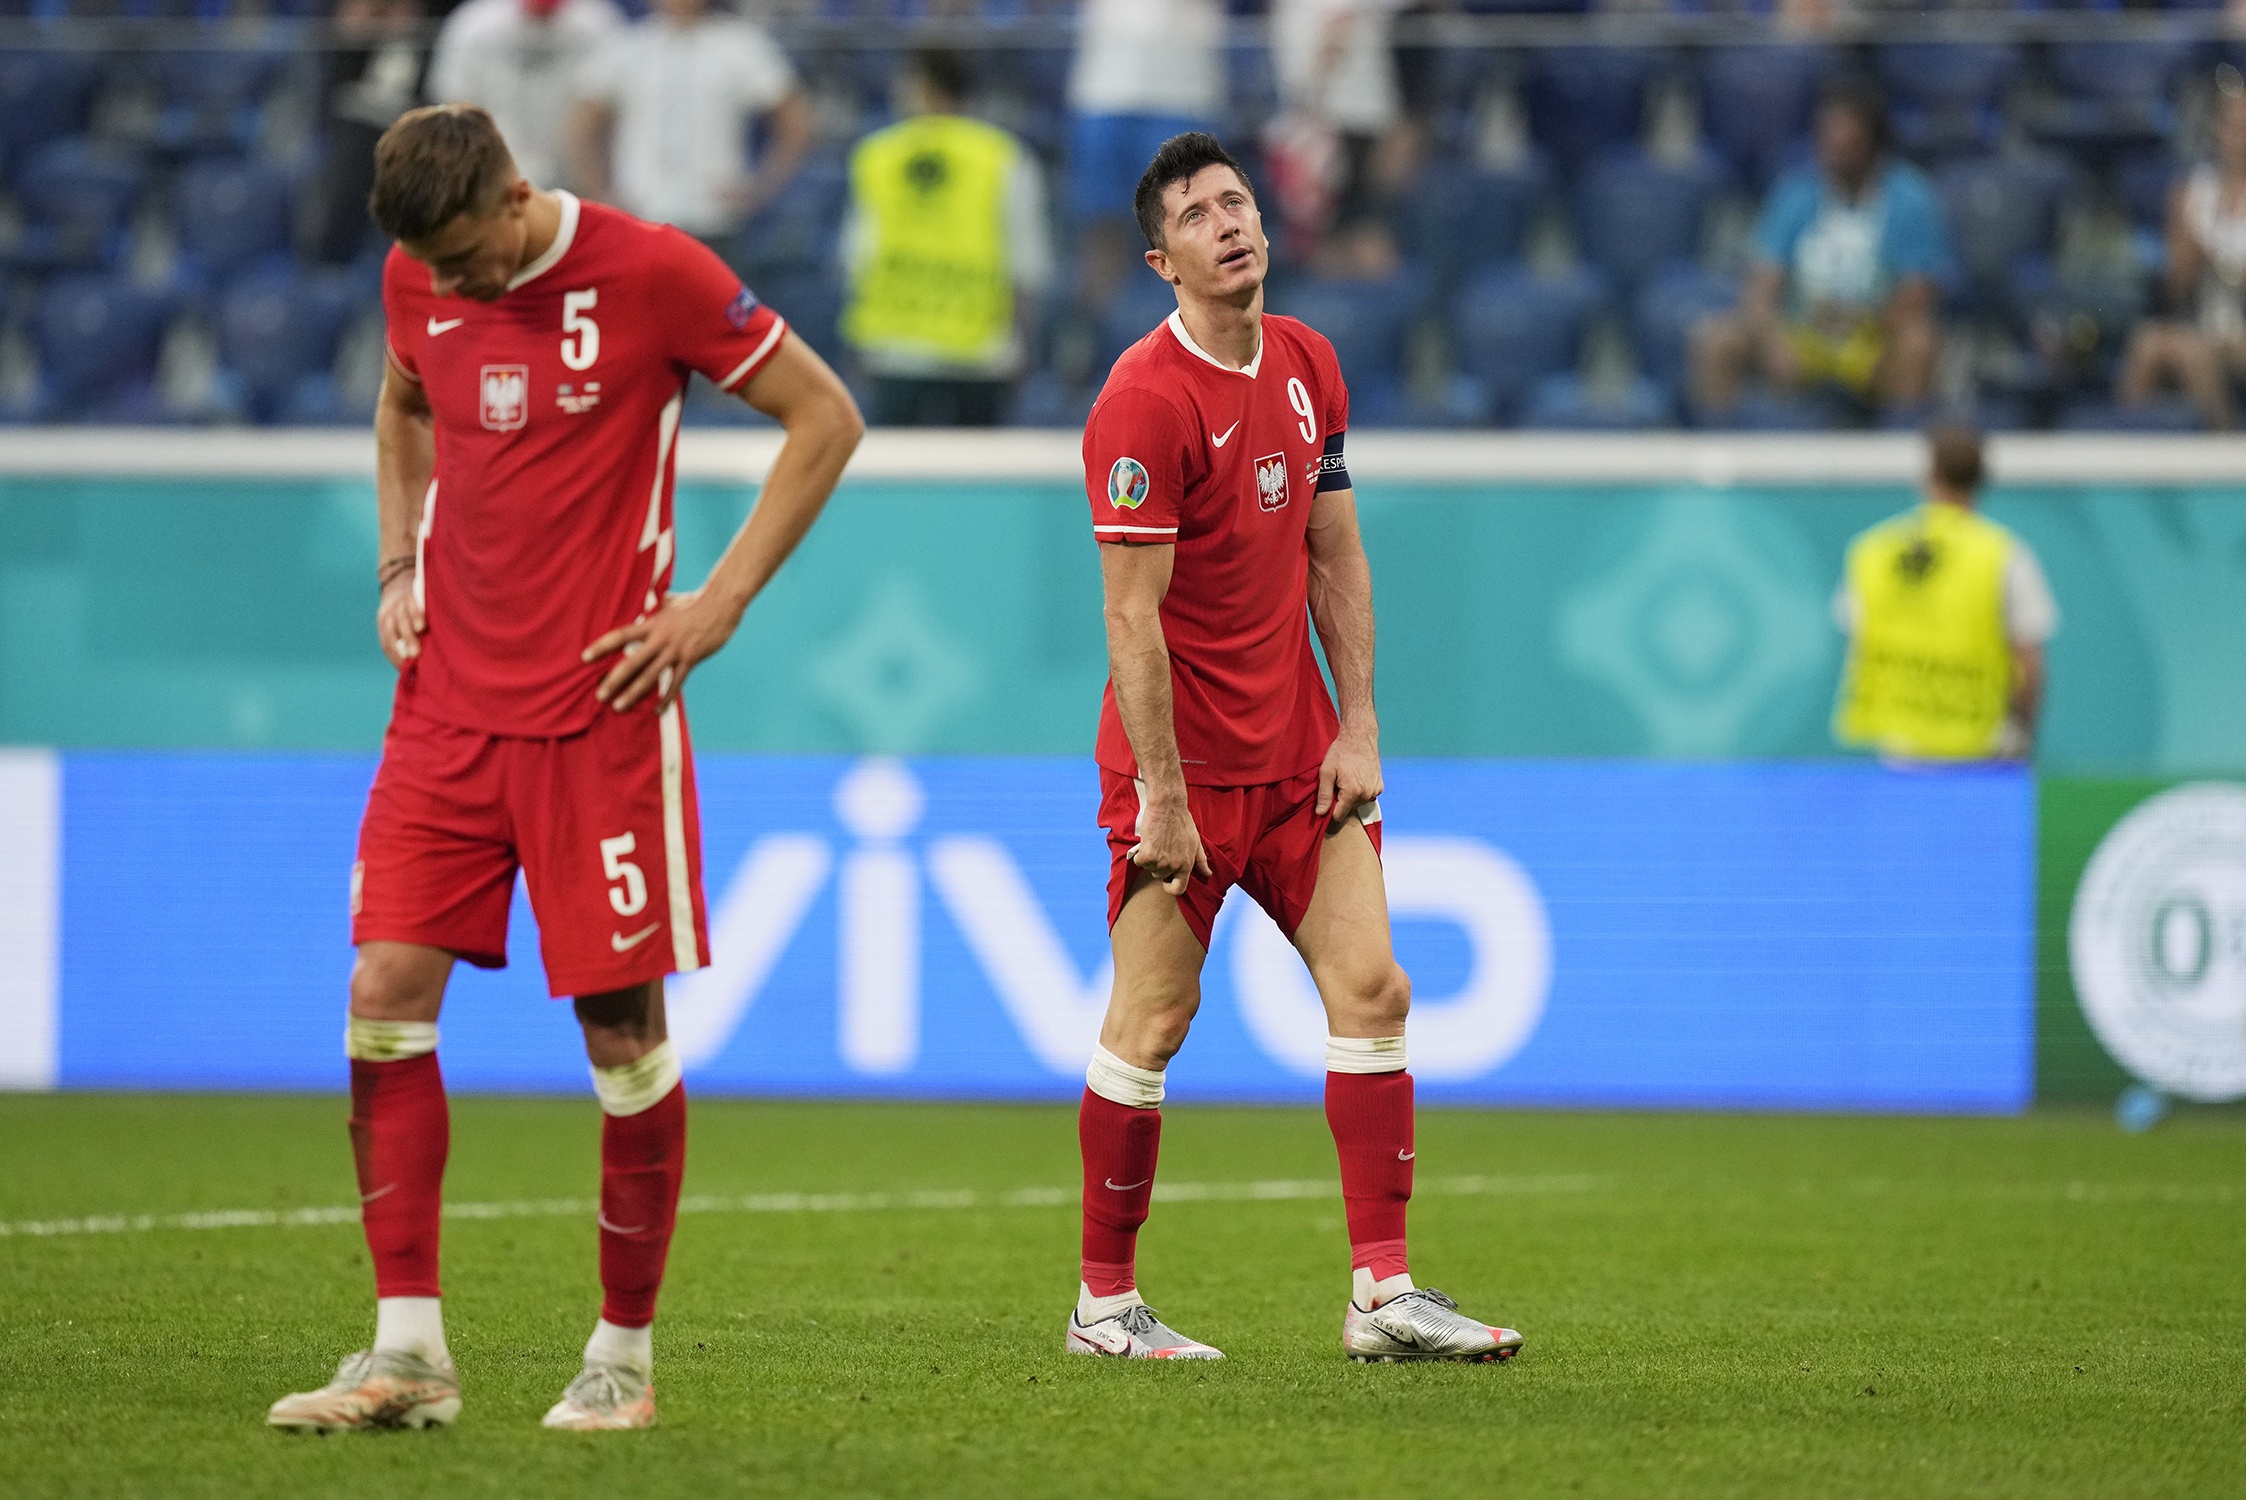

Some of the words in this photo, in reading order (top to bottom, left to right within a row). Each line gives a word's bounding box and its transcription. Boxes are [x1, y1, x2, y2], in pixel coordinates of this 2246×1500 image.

[561, 287, 600, 371] 5
[1287, 377, 1317, 444] 9
[1320, 457, 1344, 470] ESPE
[600, 831, 648, 916] 5
